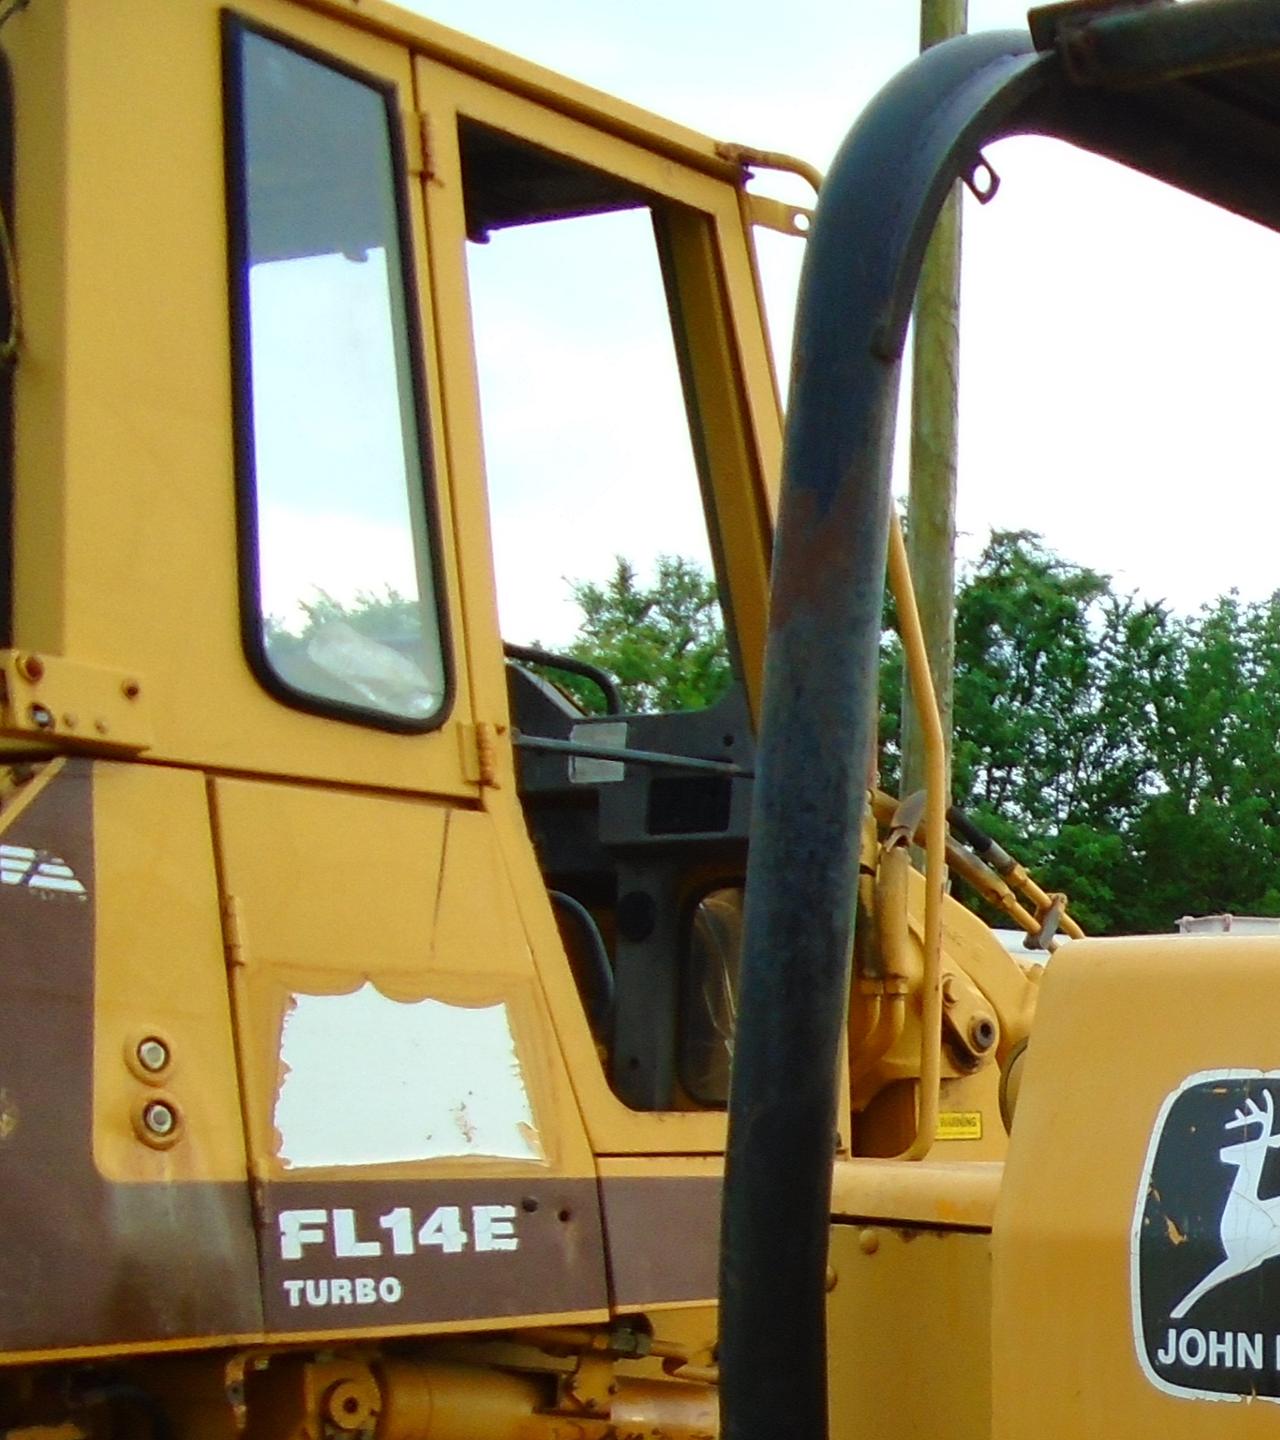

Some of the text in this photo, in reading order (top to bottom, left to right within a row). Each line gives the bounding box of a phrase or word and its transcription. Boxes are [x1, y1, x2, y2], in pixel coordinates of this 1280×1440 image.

[278, 1205, 519, 1260] FL14E
[283, 1276, 403, 1307] TURBO
[1156, 1327, 1264, 1370] JOHN
